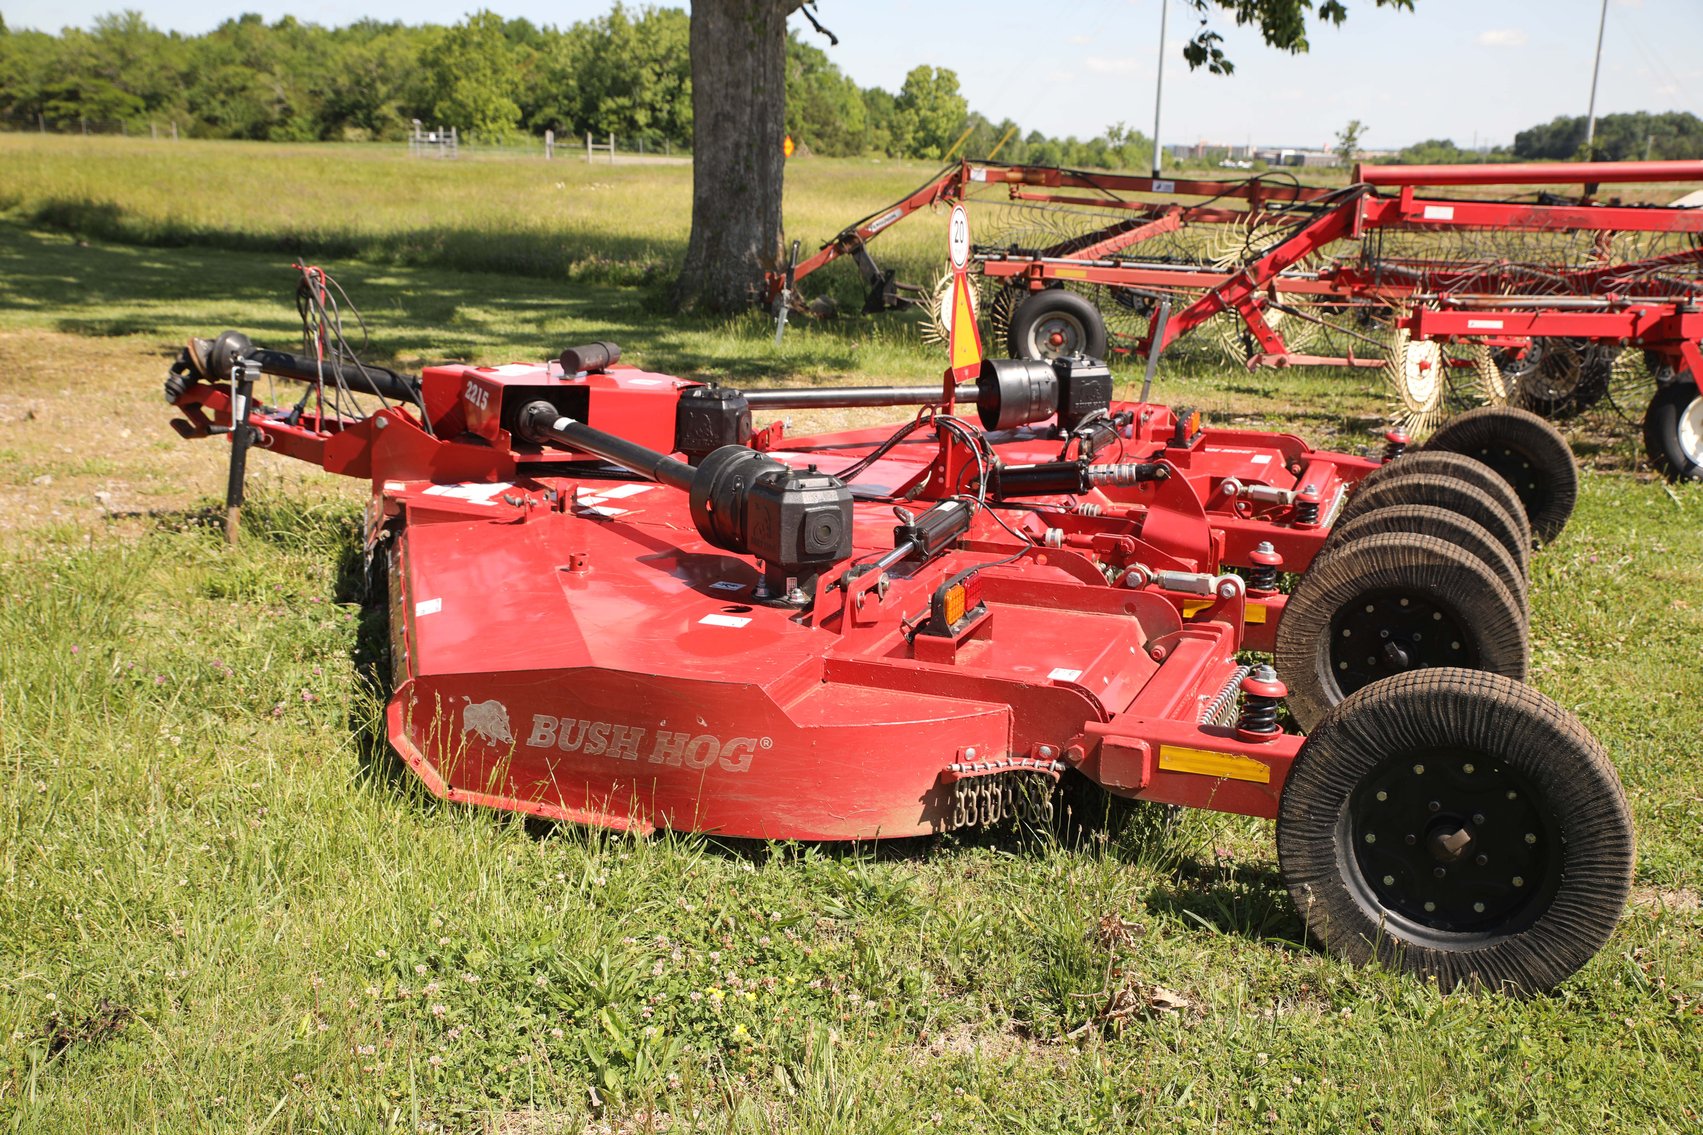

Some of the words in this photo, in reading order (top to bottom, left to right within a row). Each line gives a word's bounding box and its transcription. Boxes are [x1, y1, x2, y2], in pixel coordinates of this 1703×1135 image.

[953, 220, 964, 243] 20
[464, 380, 489, 410] 2215
[526, 713, 645, 760] BUSH
